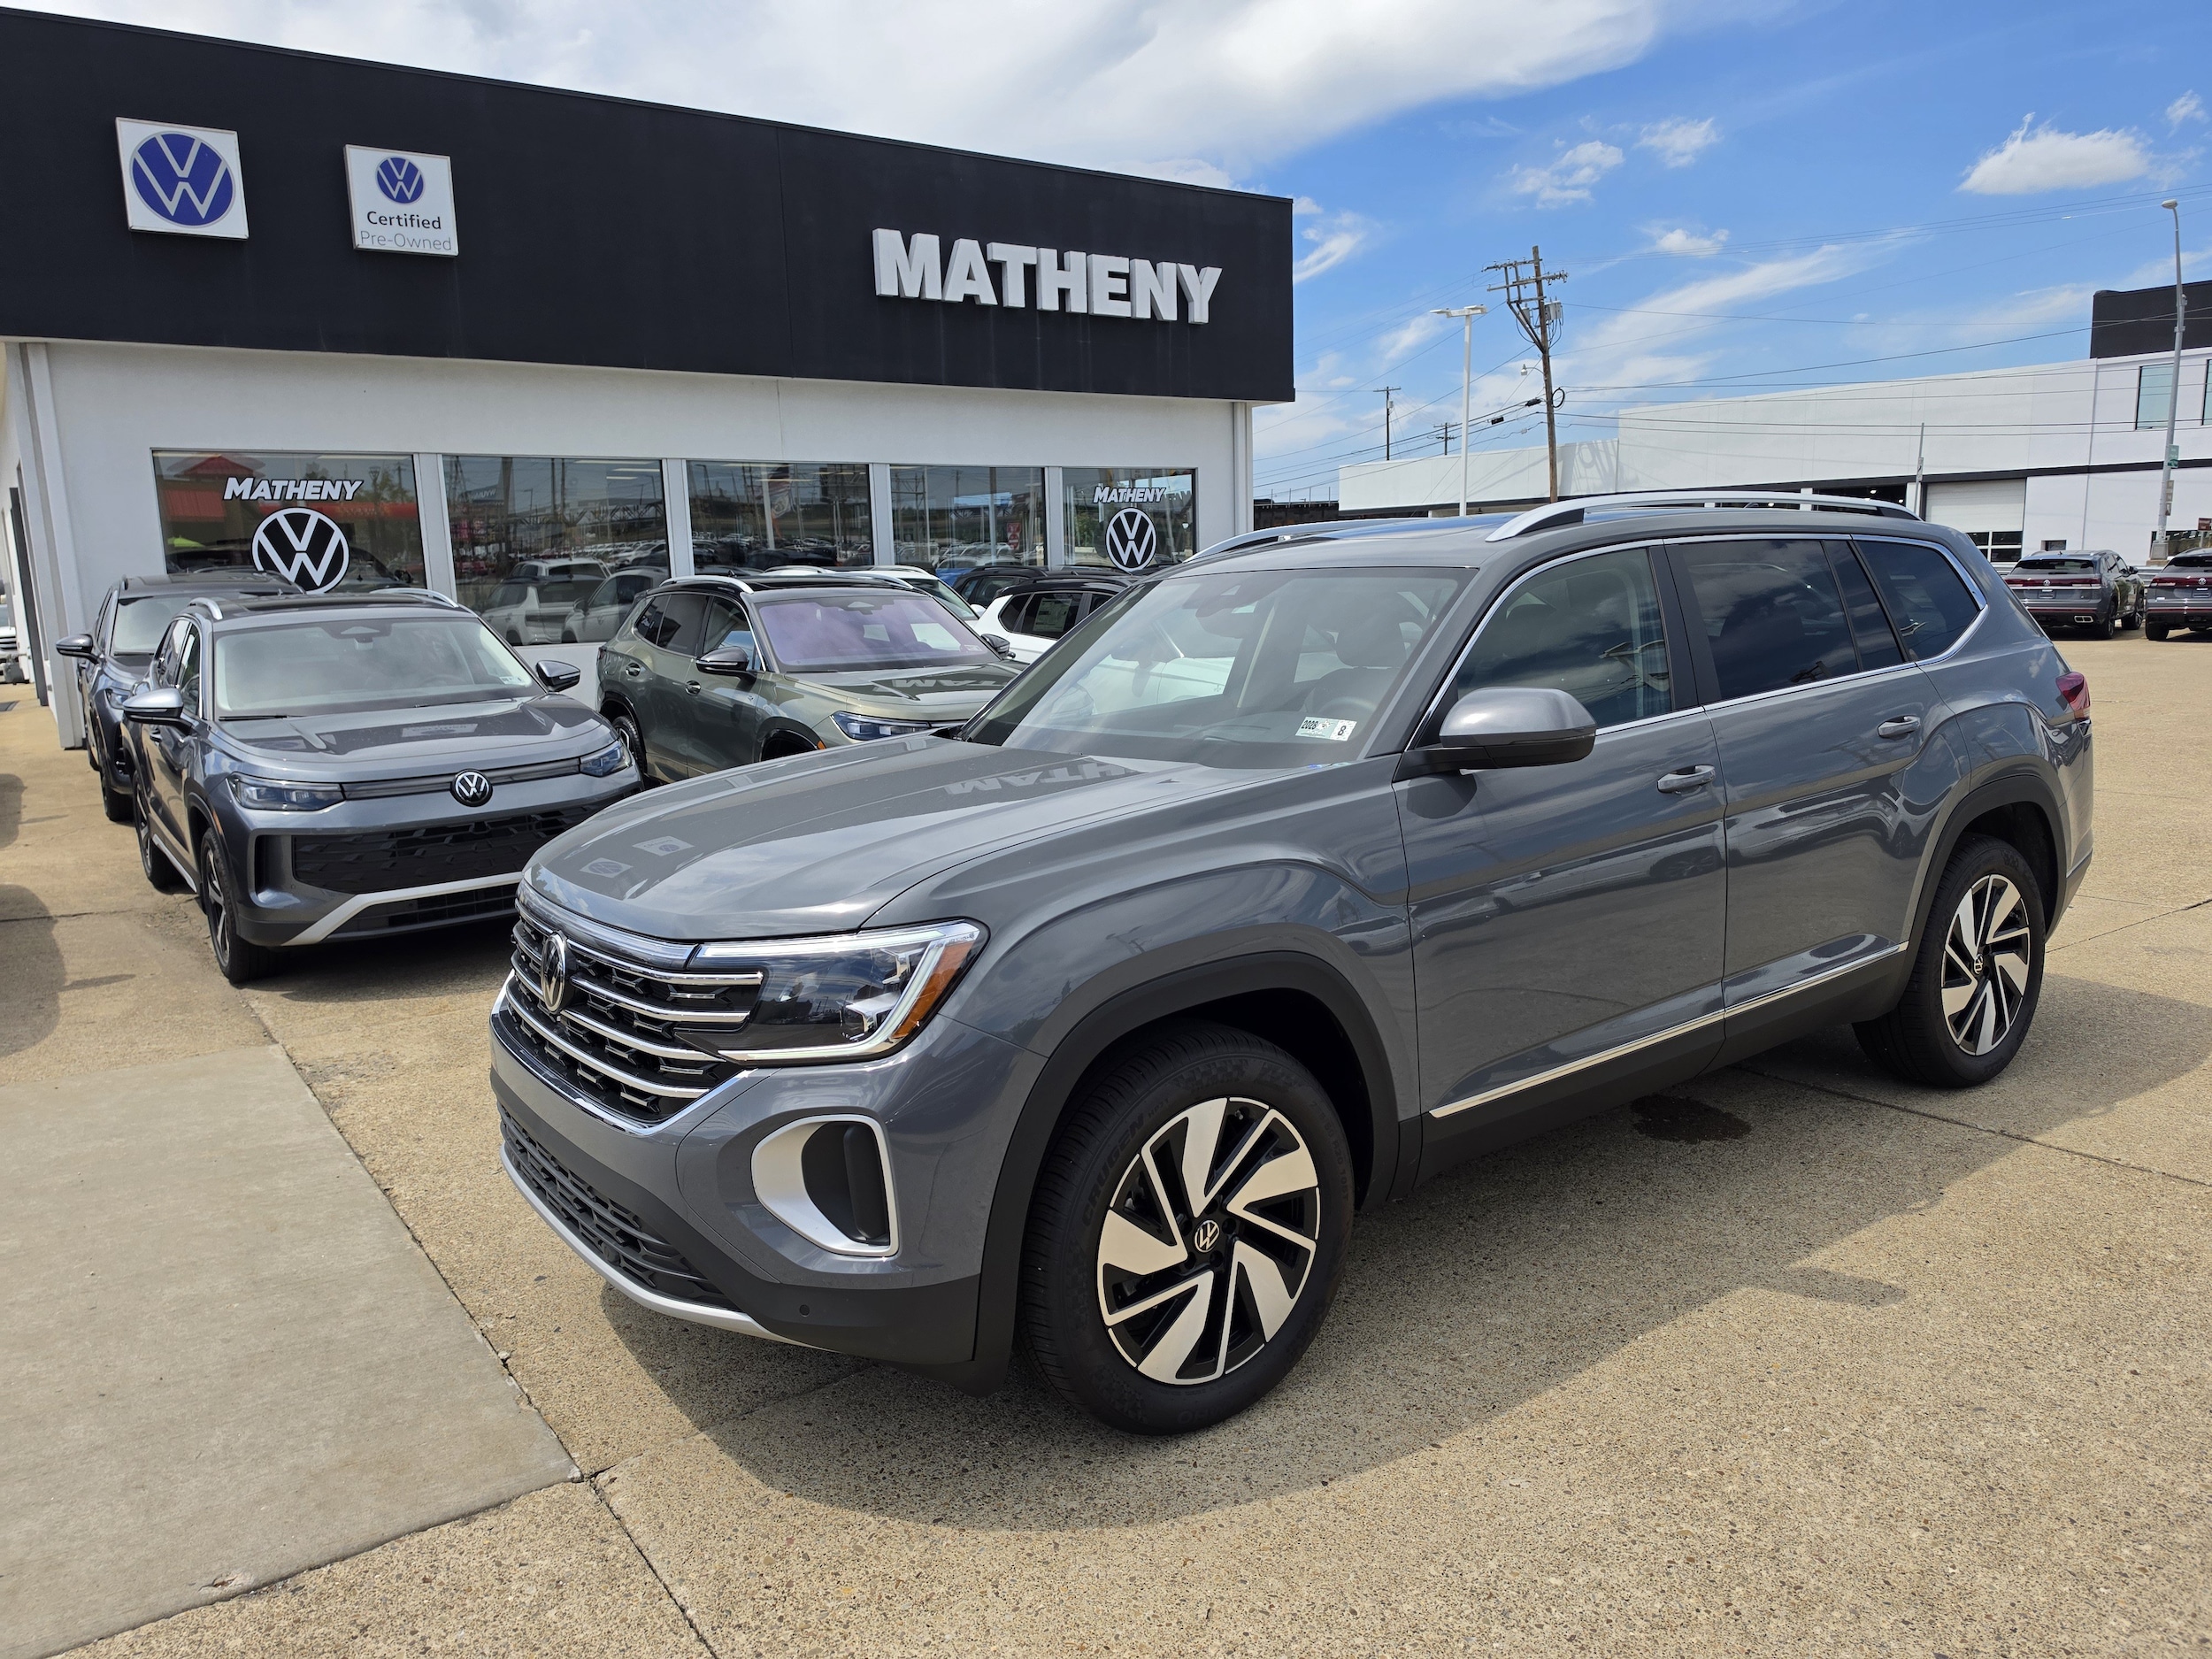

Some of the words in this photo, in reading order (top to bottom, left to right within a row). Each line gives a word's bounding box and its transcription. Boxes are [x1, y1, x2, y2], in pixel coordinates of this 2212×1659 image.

[366, 211, 442, 230] Certified
[360, 230, 452, 251] Pre-Owned
[872, 227, 1223, 325] MATHENY
[224, 477, 364, 501] MATHENY
[1093, 486, 1166, 503] MATHENY
[1338, 725, 1347, 736] 8
[1082, 1112, 1143, 1226] CRUGEN
